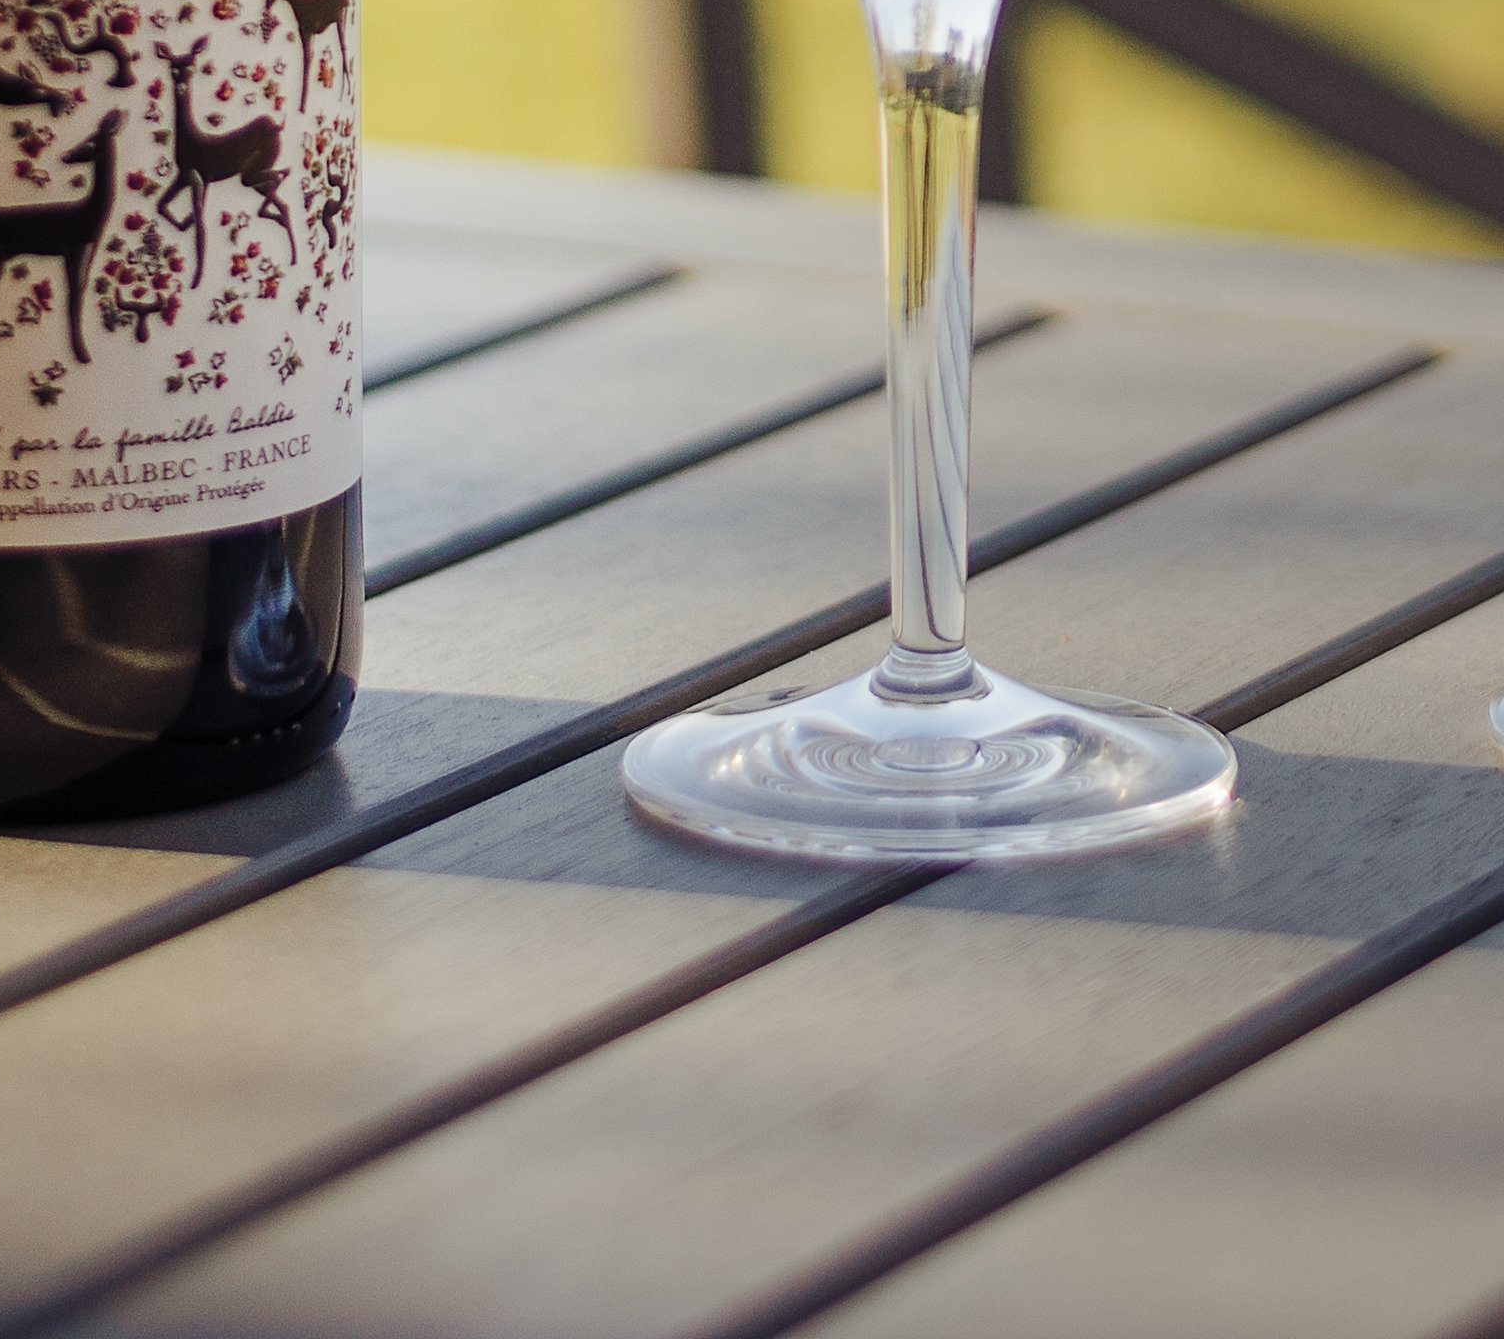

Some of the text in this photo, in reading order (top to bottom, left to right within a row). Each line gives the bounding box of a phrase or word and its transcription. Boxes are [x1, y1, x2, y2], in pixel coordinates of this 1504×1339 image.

[10, 436, 62, 461] par
[70, 427, 105, 450] la
[114, 414, 215, 463] famille
[71, 458, 197, 489] MALBEC
[223, 433, 313, 473] FRANCE
[101, 488, 191, 513] d'Origine
[196, 476, 266, 502] Protégée
